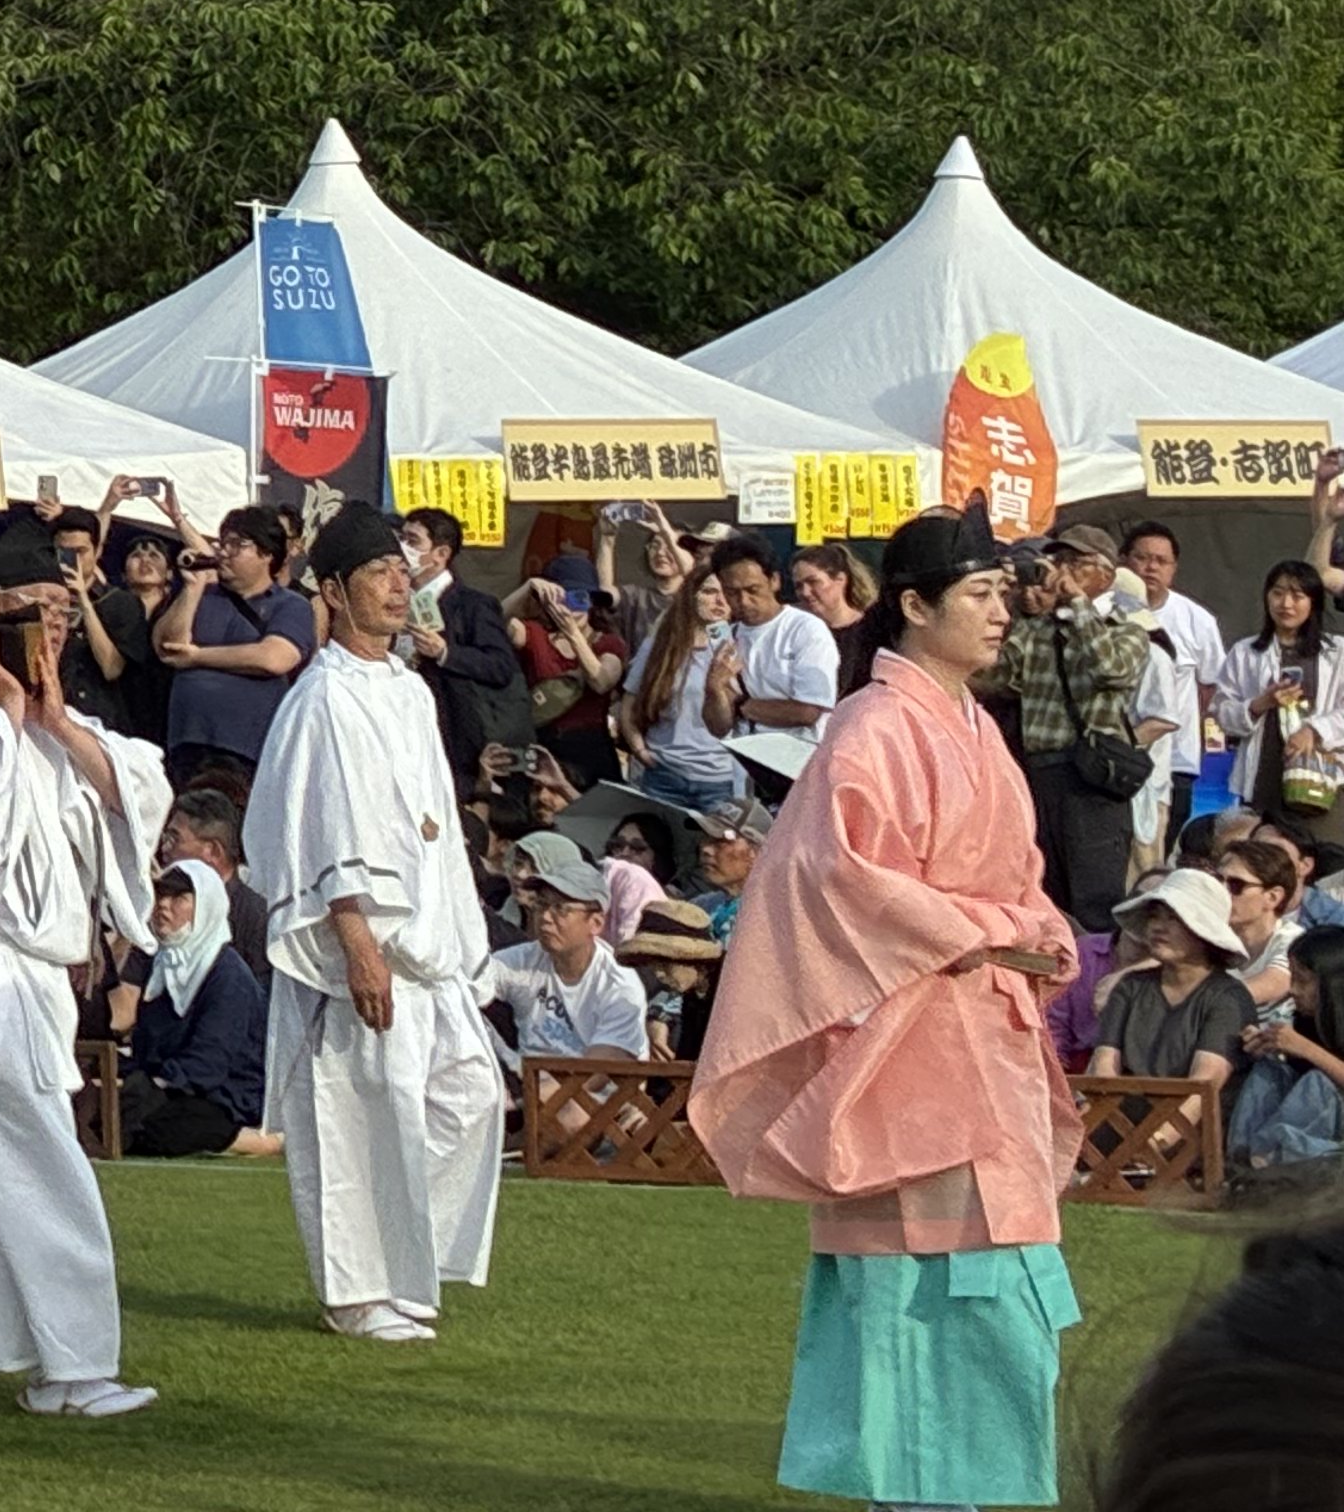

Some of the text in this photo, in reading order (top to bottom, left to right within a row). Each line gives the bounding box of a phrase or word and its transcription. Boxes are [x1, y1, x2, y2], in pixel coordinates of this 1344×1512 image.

[269, 265, 331, 288] GO TO
[273, 288, 336, 311] SUZU
[272, 392, 303, 406] NOTO
[273, 405, 356, 431] WAJIMA
[981, 415, 1036, 534] 志賀
